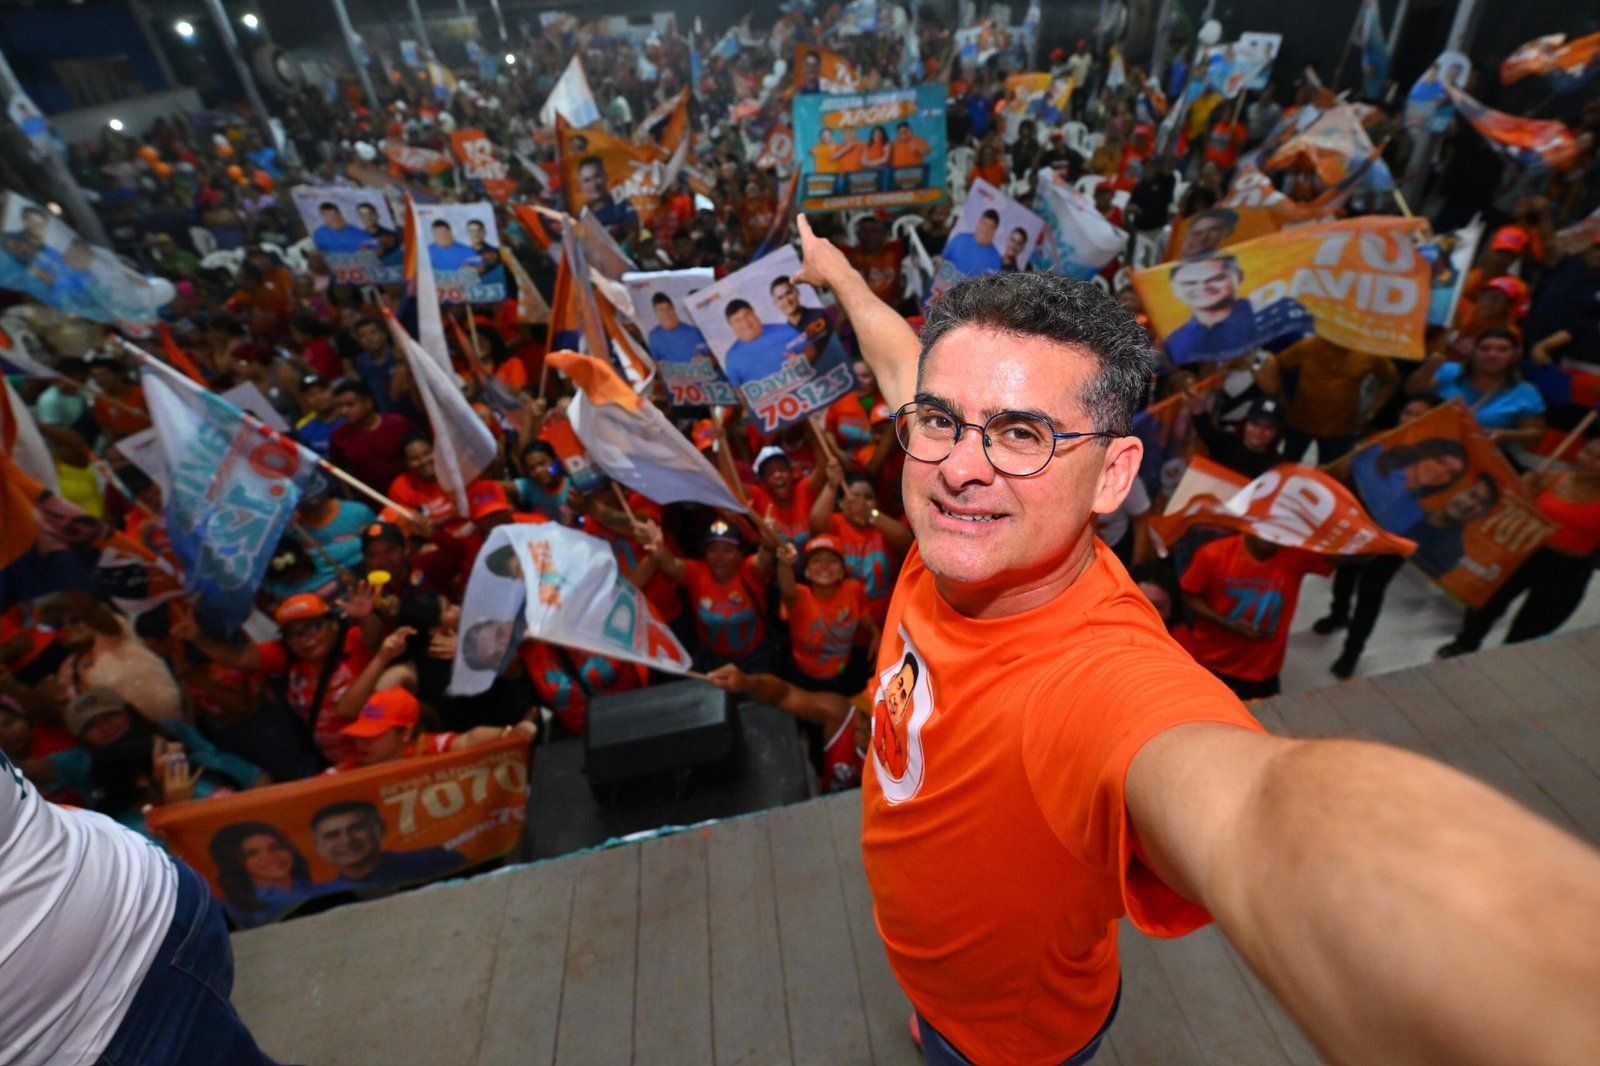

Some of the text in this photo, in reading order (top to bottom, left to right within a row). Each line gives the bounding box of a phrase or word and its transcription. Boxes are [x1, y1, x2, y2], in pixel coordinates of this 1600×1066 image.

[1312, 230, 1416, 273] 70
[1249, 267, 1420, 316] DAVID
[671, 383, 736, 404] 70.12
[744, 355, 812, 401] David
[758, 362, 854, 432] 70.123
[383, 760, 527, 834] 7070
